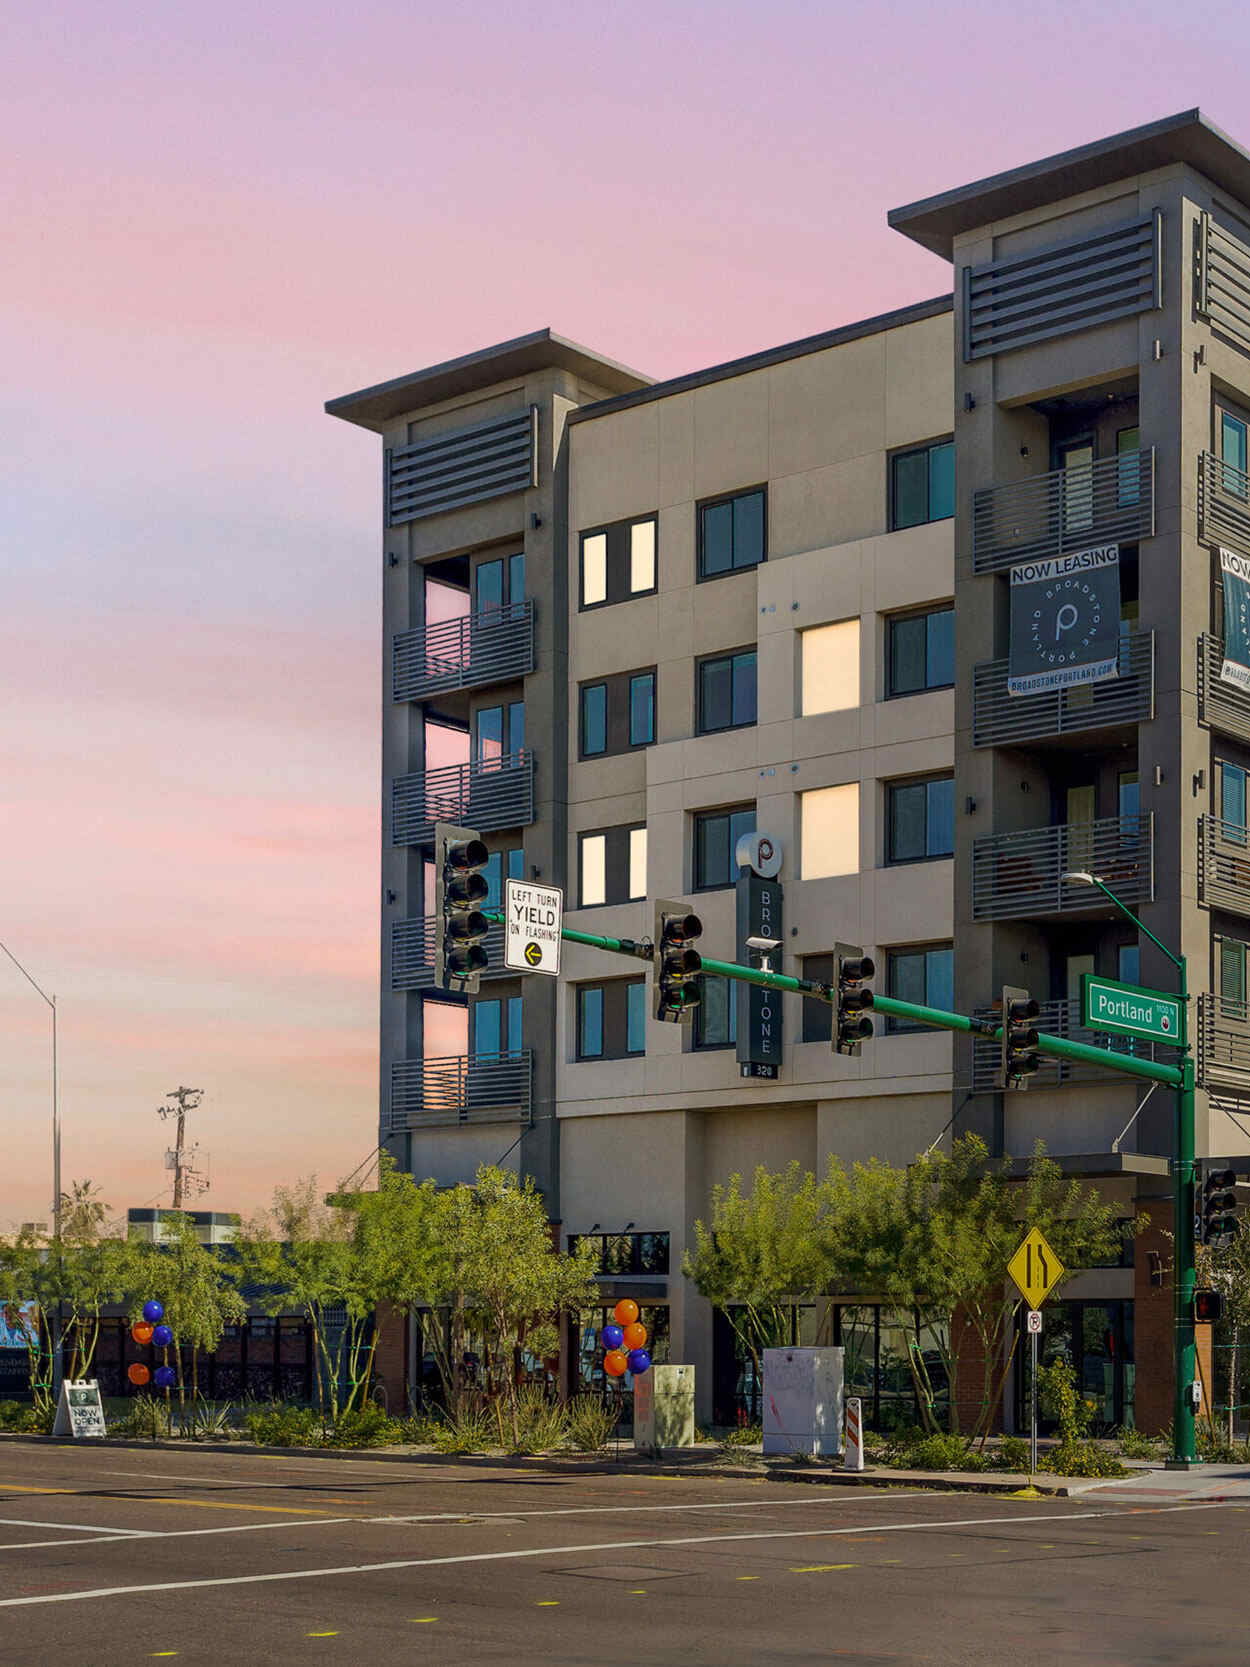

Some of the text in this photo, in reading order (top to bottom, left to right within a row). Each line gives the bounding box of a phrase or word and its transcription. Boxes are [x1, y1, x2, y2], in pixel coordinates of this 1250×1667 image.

[1013, 547, 1117, 582] NOW LEASING
[512, 889, 557, 908] LEFT TURN
[514, 904, 555, 927] YIELD
[511, 923, 557, 941] ON FLASHING
[761, 891, 771, 1053] BROTONE
[1099, 995, 1152, 1024] Portland
[73, 1408, 97, 1417] NOW
[75, 1417, 100, 1425] OPEN
